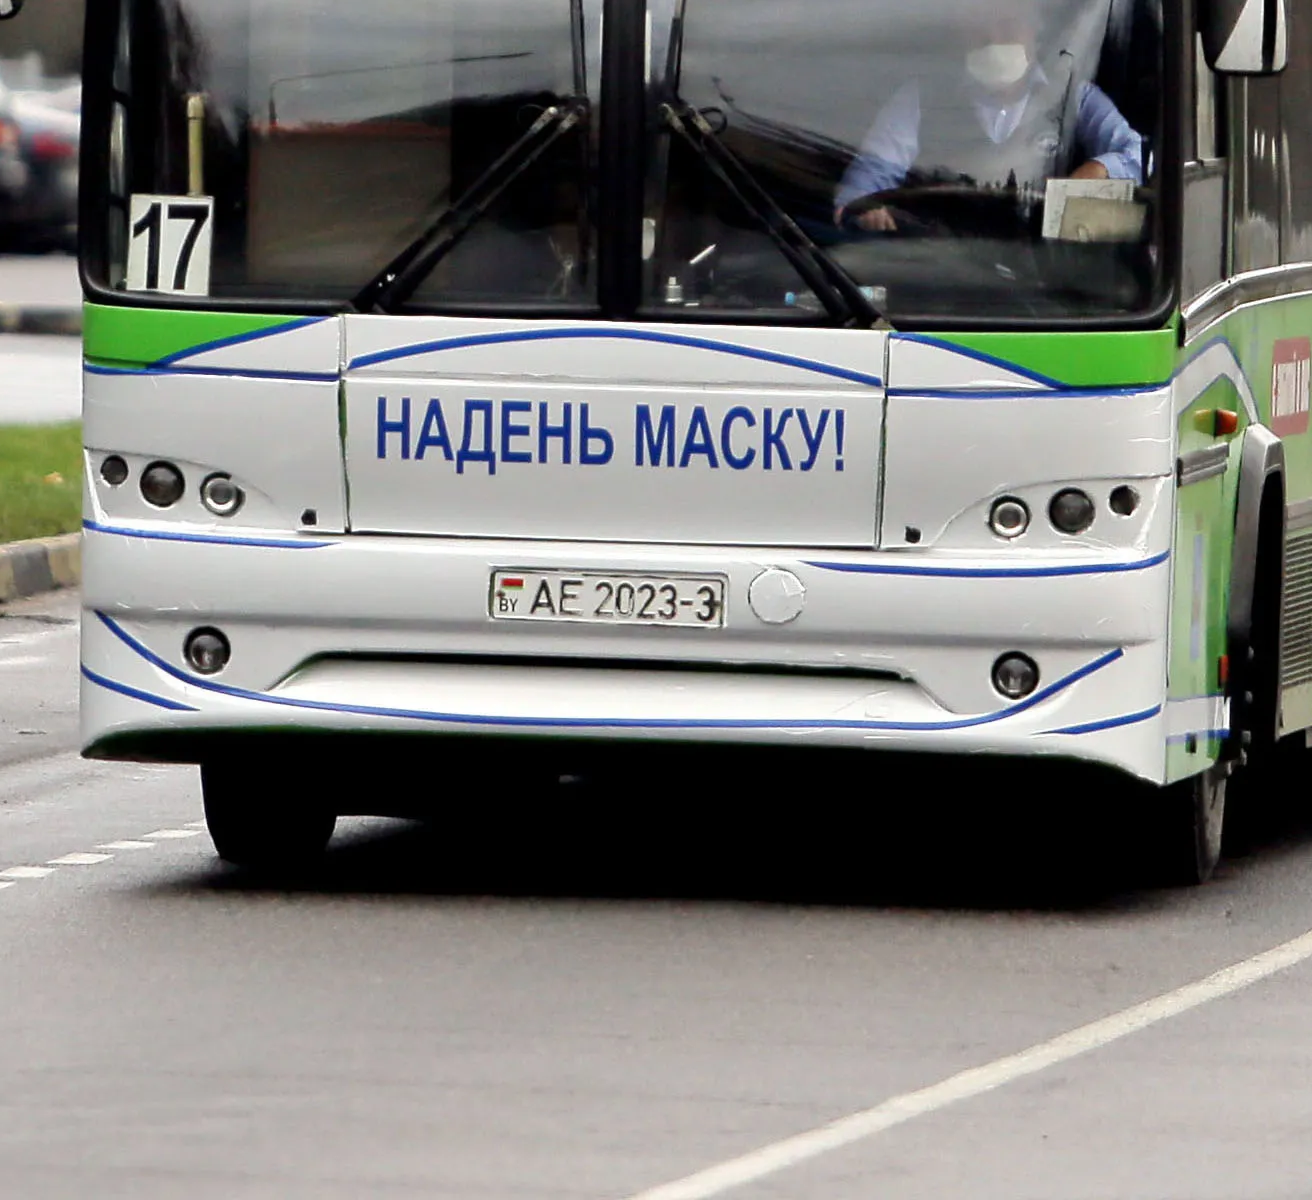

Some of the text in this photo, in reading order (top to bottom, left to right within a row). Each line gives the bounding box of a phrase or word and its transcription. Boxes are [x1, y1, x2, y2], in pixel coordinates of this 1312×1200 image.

[133, 203, 210, 291] 17
[377, 397, 844, 474] НАДЕНЬ МАСКУ!
[499, 578, 716, 623] BY AE 2023-3
